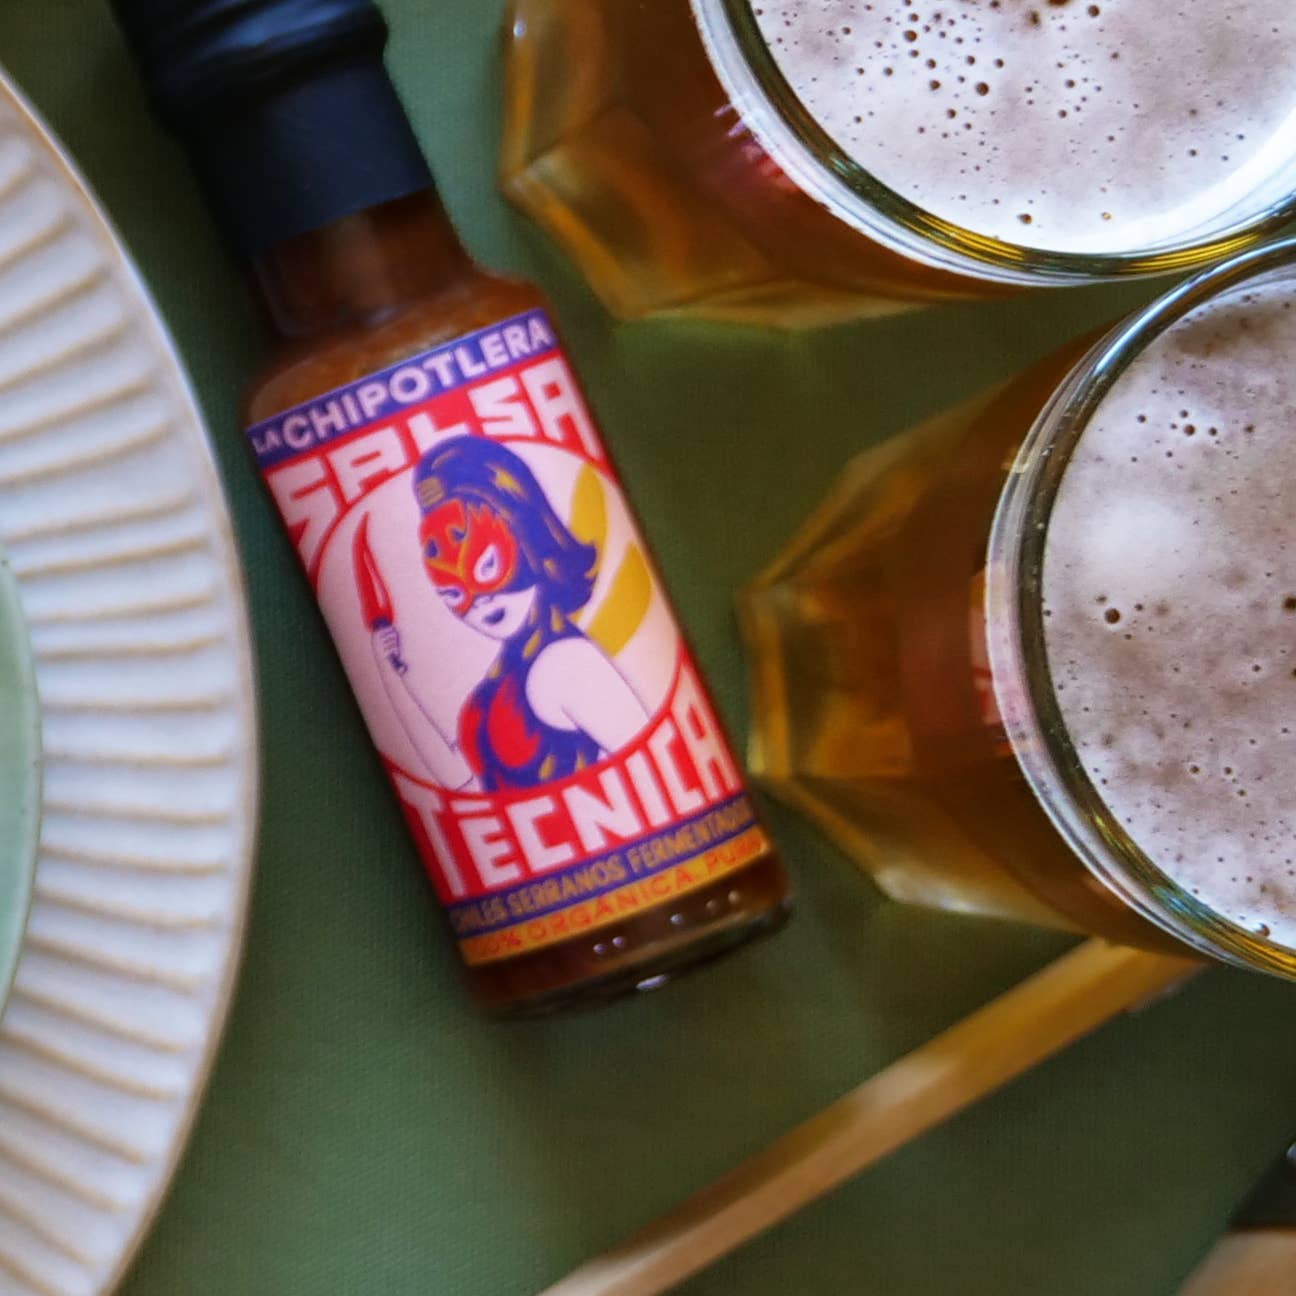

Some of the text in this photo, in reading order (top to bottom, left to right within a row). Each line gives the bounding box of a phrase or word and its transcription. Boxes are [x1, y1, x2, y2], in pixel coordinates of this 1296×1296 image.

[266, 354, 605, 567] SALSA
[281, 317, 554, 450] CHIPOTLERA
[393, 661, 743, 898] TÉCNICA
[507, 857, 627, 915] SERRANOS
